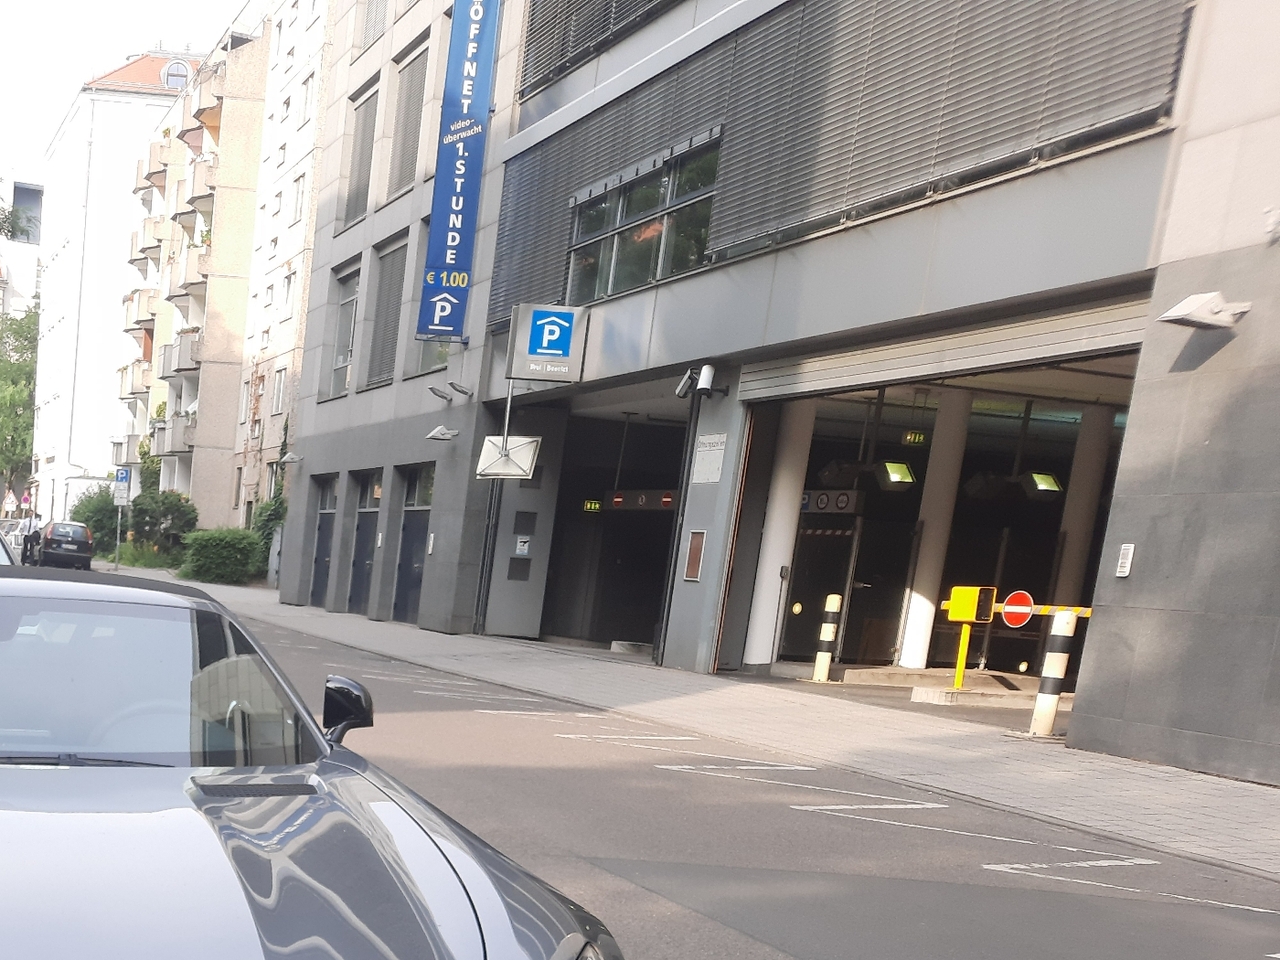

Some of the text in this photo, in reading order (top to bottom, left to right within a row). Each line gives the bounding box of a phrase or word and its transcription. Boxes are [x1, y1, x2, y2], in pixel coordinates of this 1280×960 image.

[461, 0, 483, 114] ÖFFNET
[443, 125, 482, 144] überwacht
[450, 119, 475, 131] video-
[426, 271, 468, 287] € 1.00
[542, 324, 561, 347] P
